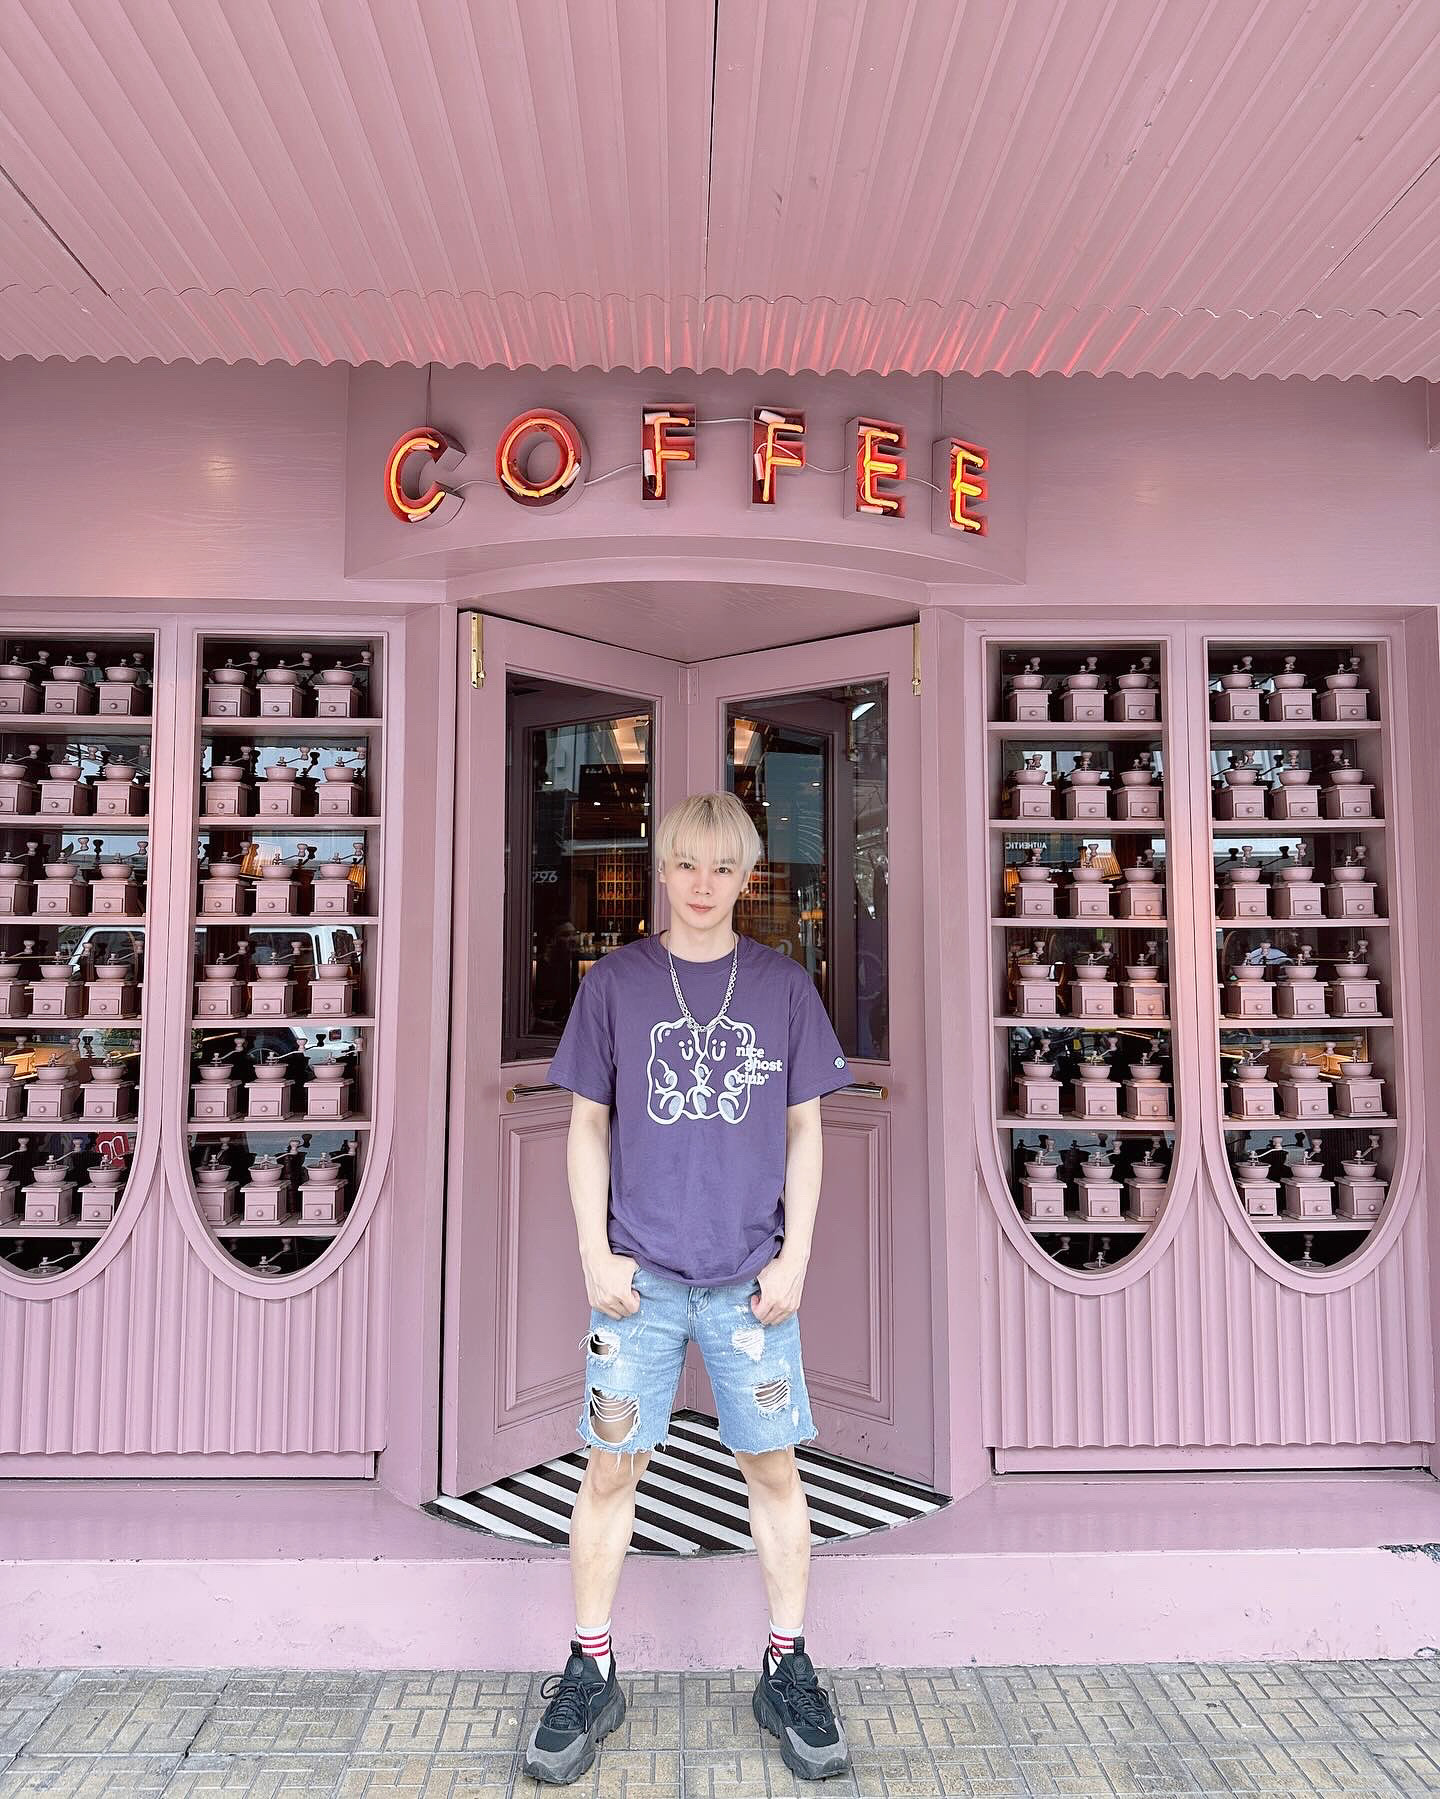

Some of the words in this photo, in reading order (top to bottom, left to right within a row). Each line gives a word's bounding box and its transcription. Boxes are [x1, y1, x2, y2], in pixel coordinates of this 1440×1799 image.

[385, 403, 991, 537] COFFEE
[735, 1045, 765, 1058] nice
[744, 1057, 783, 1072] ghost
